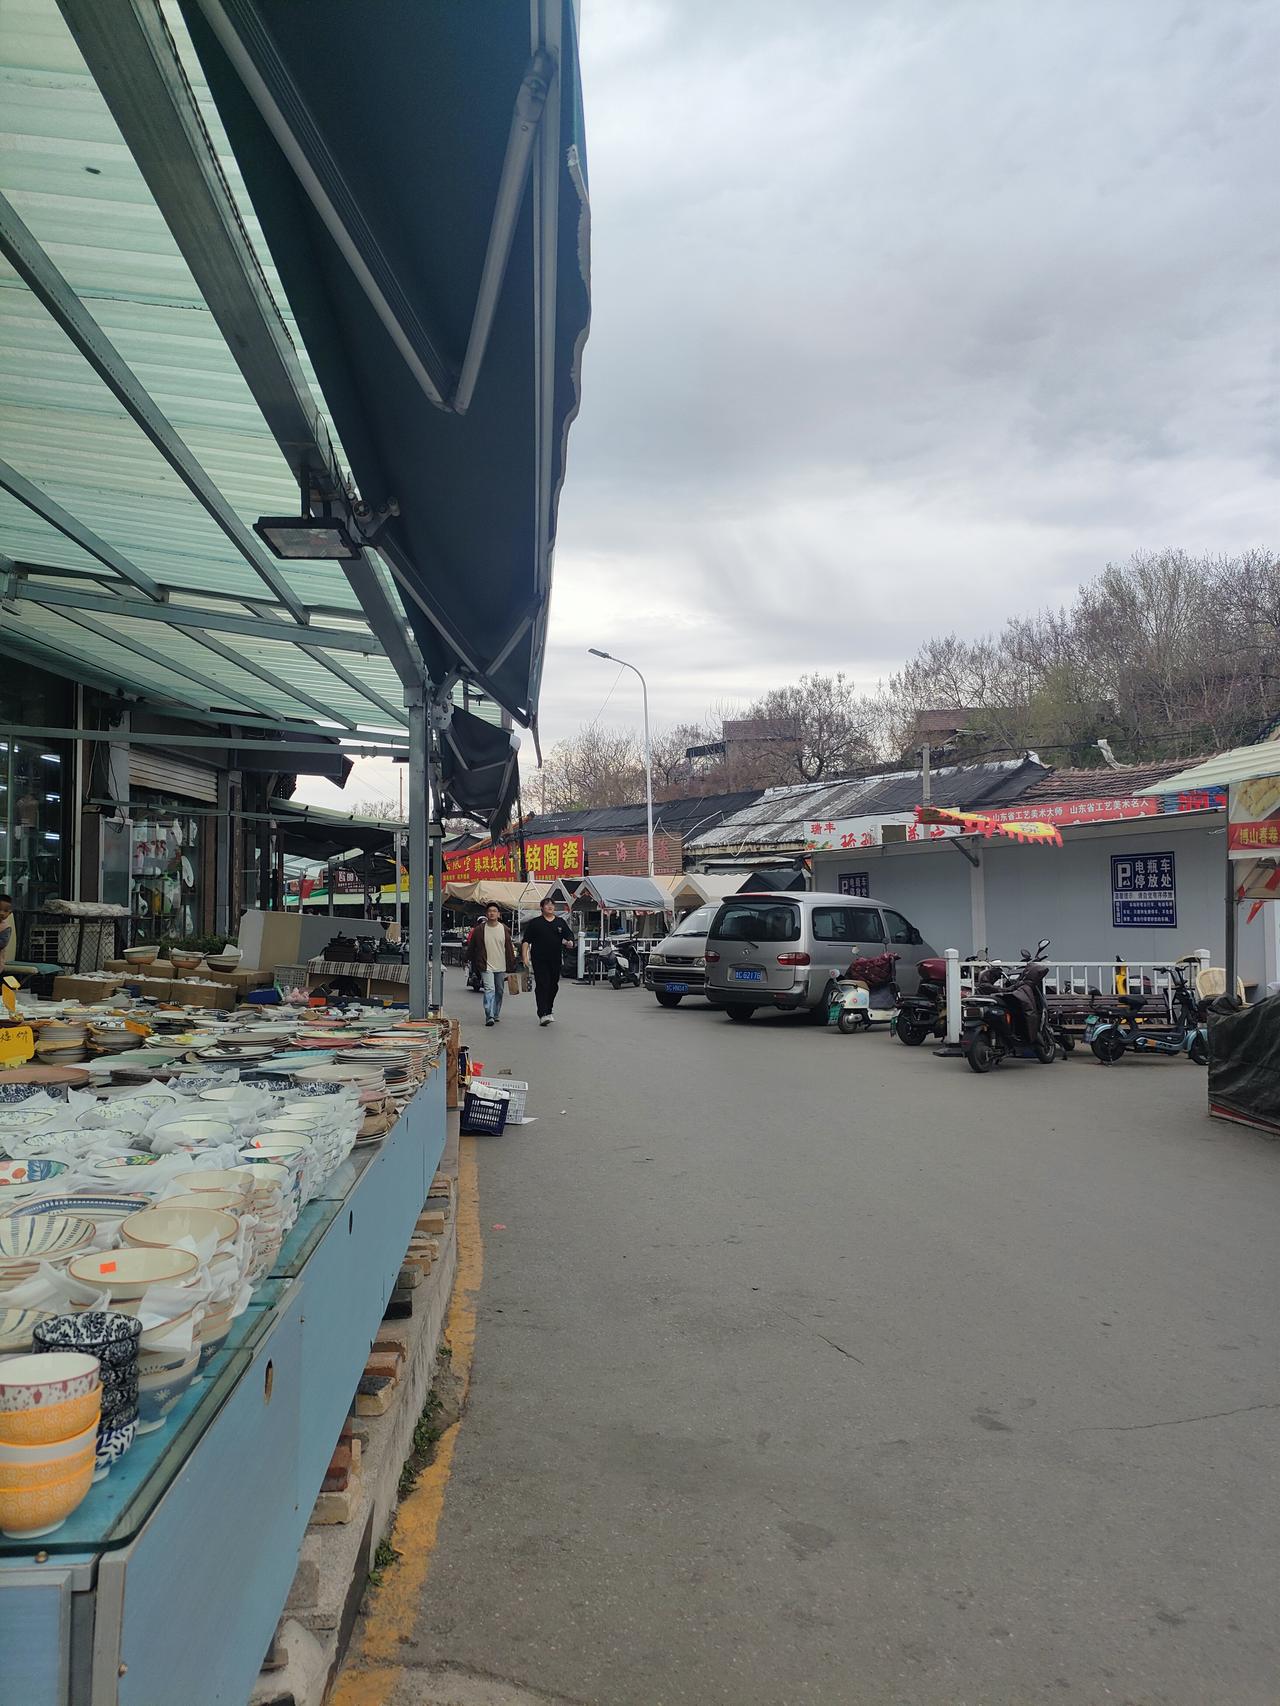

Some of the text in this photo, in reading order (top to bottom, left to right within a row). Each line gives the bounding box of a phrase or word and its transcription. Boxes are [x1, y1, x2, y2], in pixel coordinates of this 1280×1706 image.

[992, 806, 1063, 822] 山东省工艺美术大师
[1070, 798, 1149, 815] 山东省工艺美术名人
[1117, 858, 1171, 888] P 电瓶车
[1135, 874, 1172, 889] 停放处
